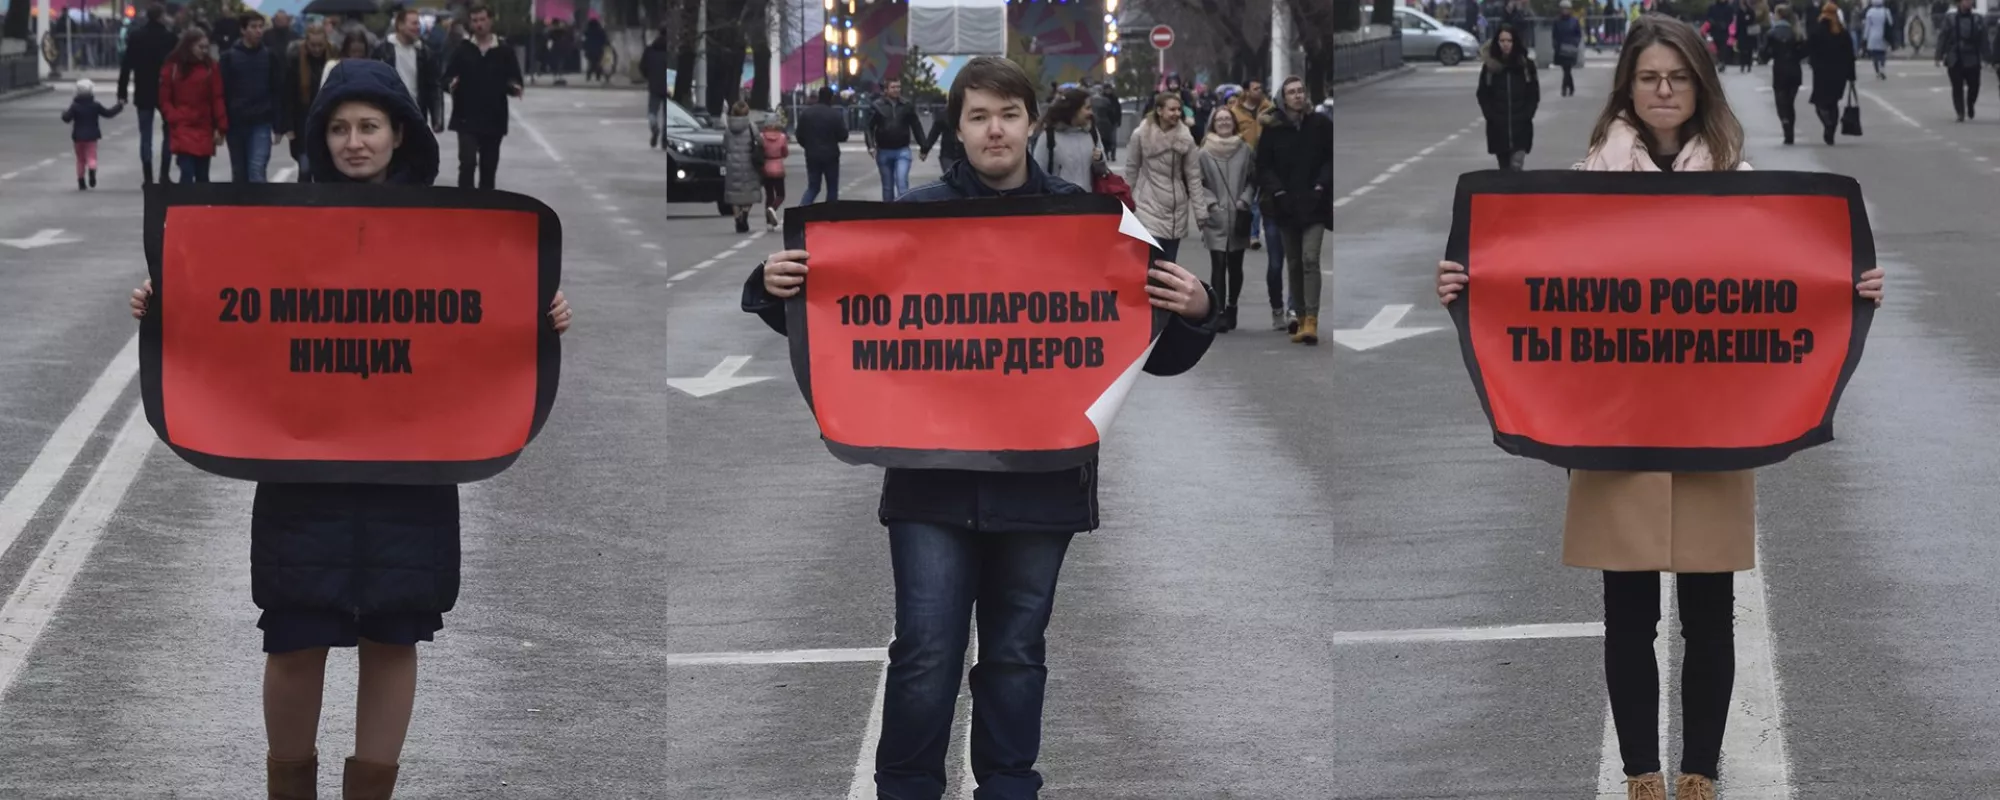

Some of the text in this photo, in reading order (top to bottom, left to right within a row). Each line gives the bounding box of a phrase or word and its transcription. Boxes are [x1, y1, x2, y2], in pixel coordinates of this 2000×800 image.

[219, 287, 483, 324] 20 МИЛЛИОНОВ
[837, 290, 1120, 329] 100 ДОЛЛАРОВЫХ
[1525, 277, 1797, 315] ТАКУЮ РОССИЮ
[289, 337, 412, 379] НИЩИХ
[853, 337, 1104, 374] МИЛЛИАРДЕРОВ
[1507, 327, 1814, 364] ТЫ ВЫБИРАЕШЬ?
